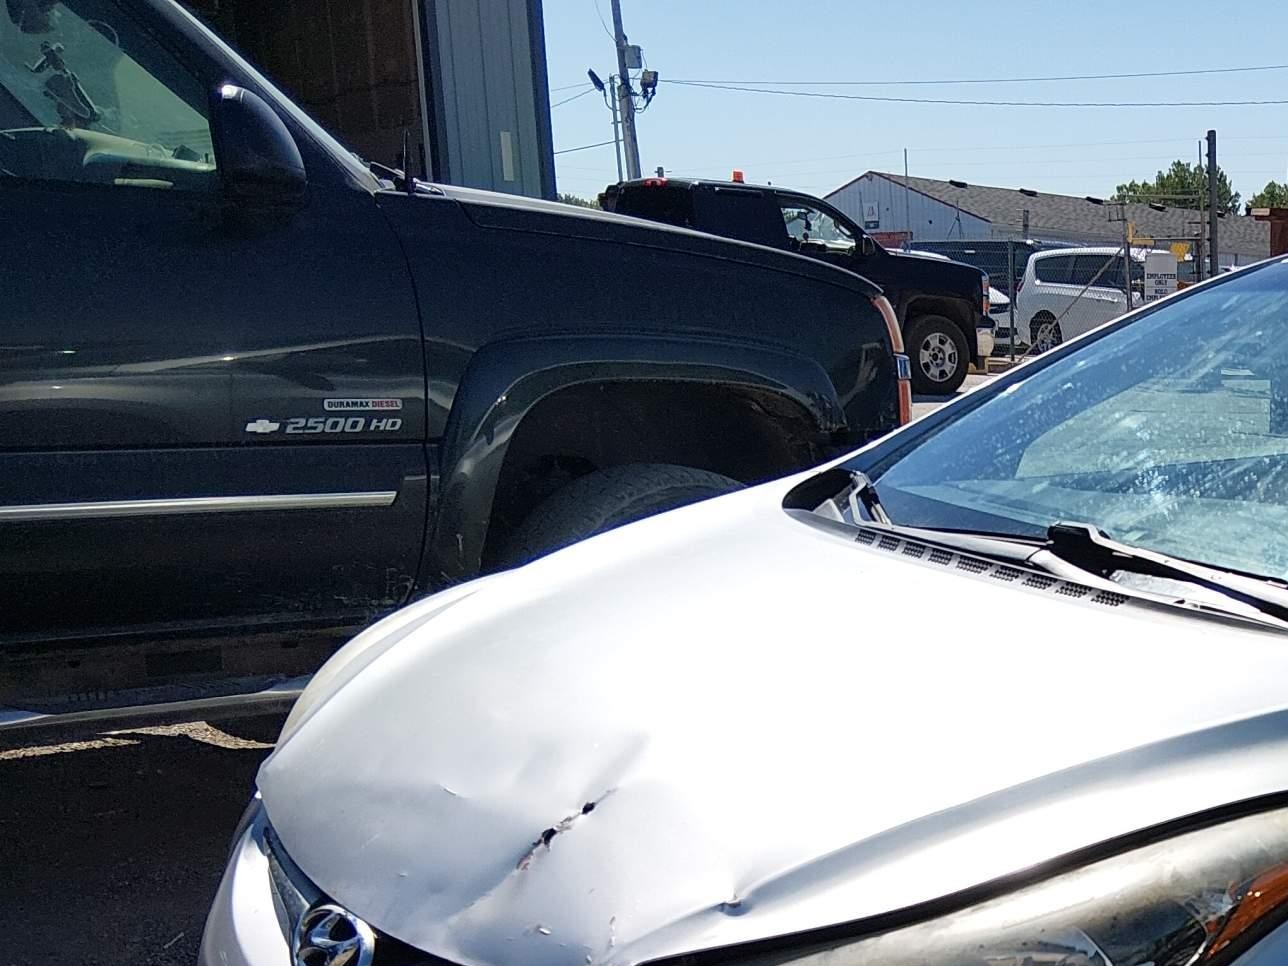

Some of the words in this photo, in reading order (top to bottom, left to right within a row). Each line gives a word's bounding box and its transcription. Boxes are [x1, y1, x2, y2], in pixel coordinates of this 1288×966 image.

[327, 400, 370, 408] DURAMAX
[371, 400, 400, 408] DIESEL
[285, 418, 365, 434] 2500
[369, 418, 402, 431] HD
